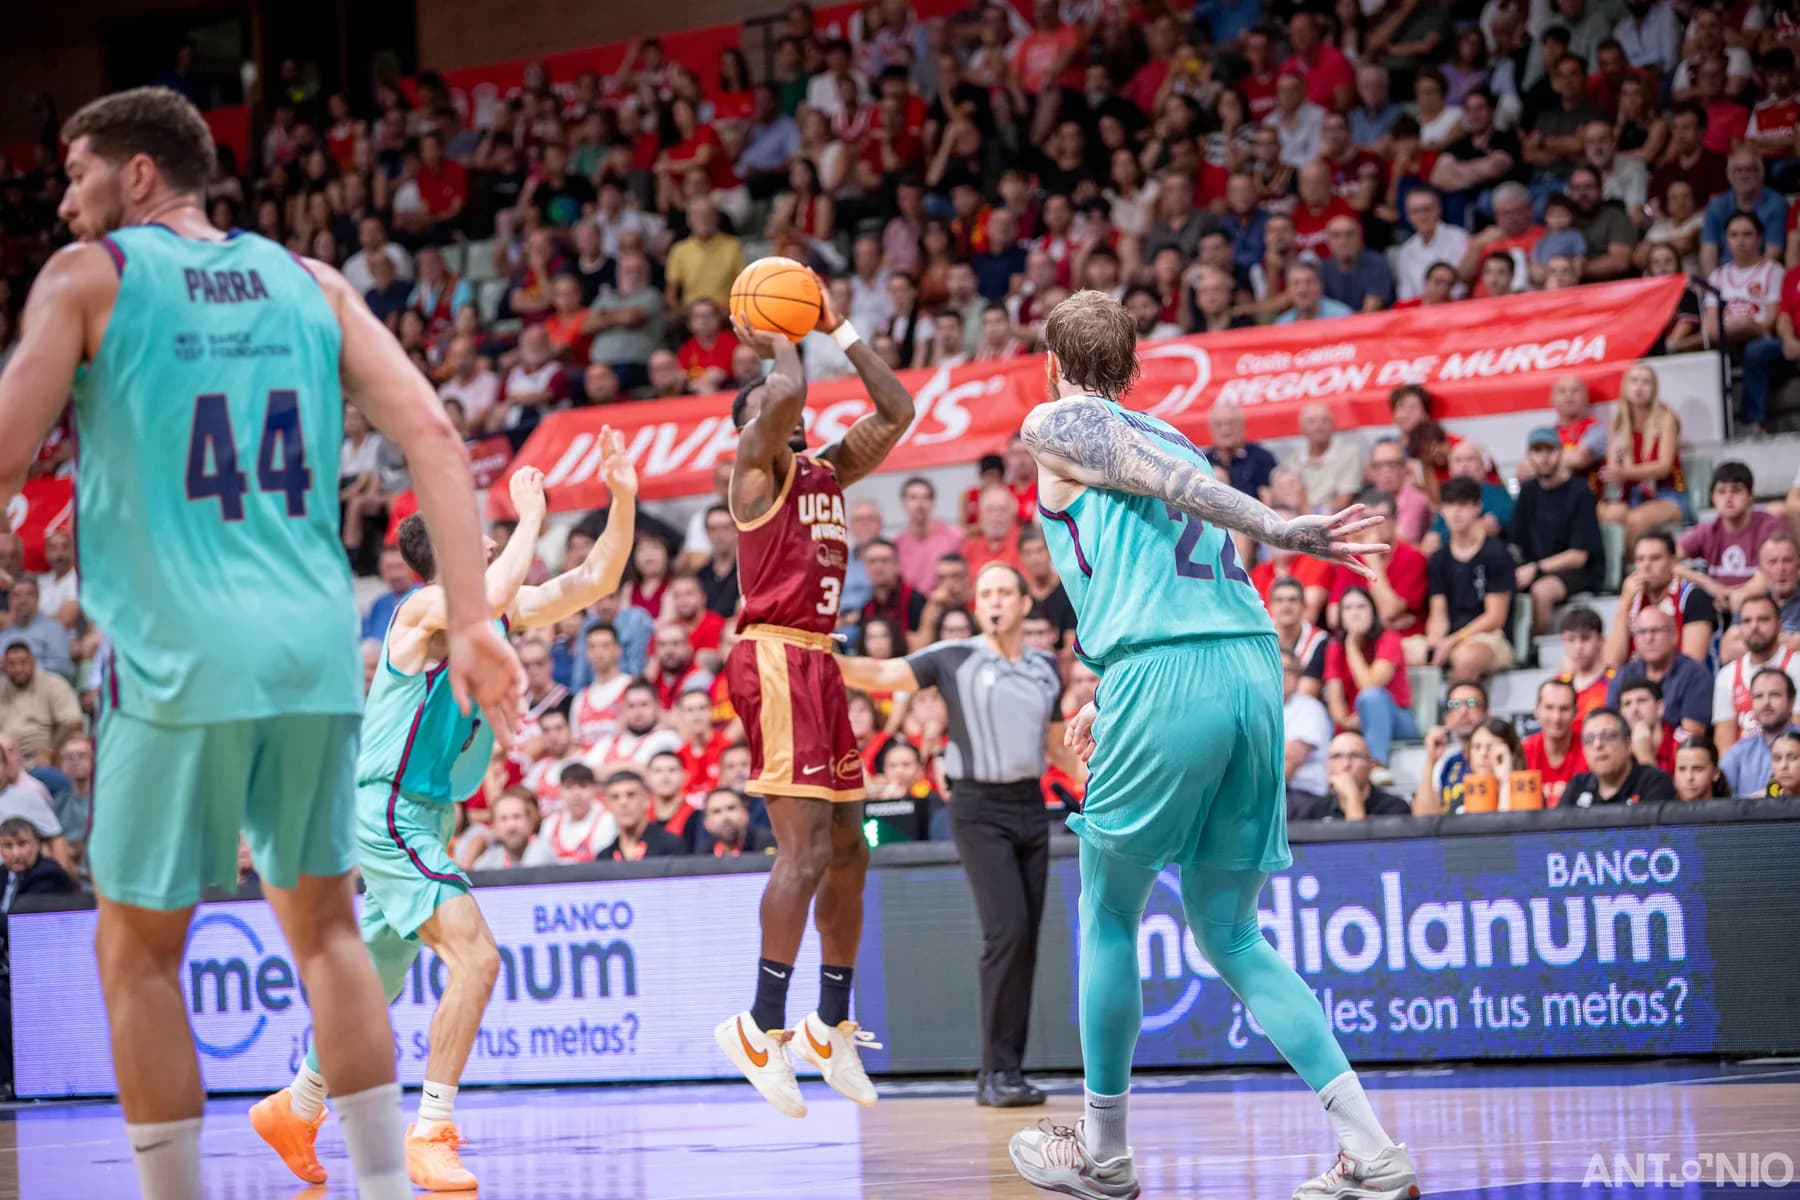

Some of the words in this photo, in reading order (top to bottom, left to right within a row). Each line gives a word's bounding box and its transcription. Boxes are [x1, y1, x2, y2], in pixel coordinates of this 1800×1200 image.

[183, 267, 270, 304] PARRA
[1377, 355, 1438, 385] DE
[1440, 335, 1606, 380] MURCIA
[185, 388, 313, 522] 44
[798, 493, 846, 525] UCA
[816, 576, 840, 616] 3
[1547, 848, 1680, 888] BANCO
[533, 901, 634, 934] BANCO
[1228, 987, 1379, 1049] ¿les
[1389, 995, 1458, 1033] son
[1469, 985, 1531, 1029] tus
[1542, 976, 1689, 1028] metas?
[530, 1012, 640, 1056] metas?
